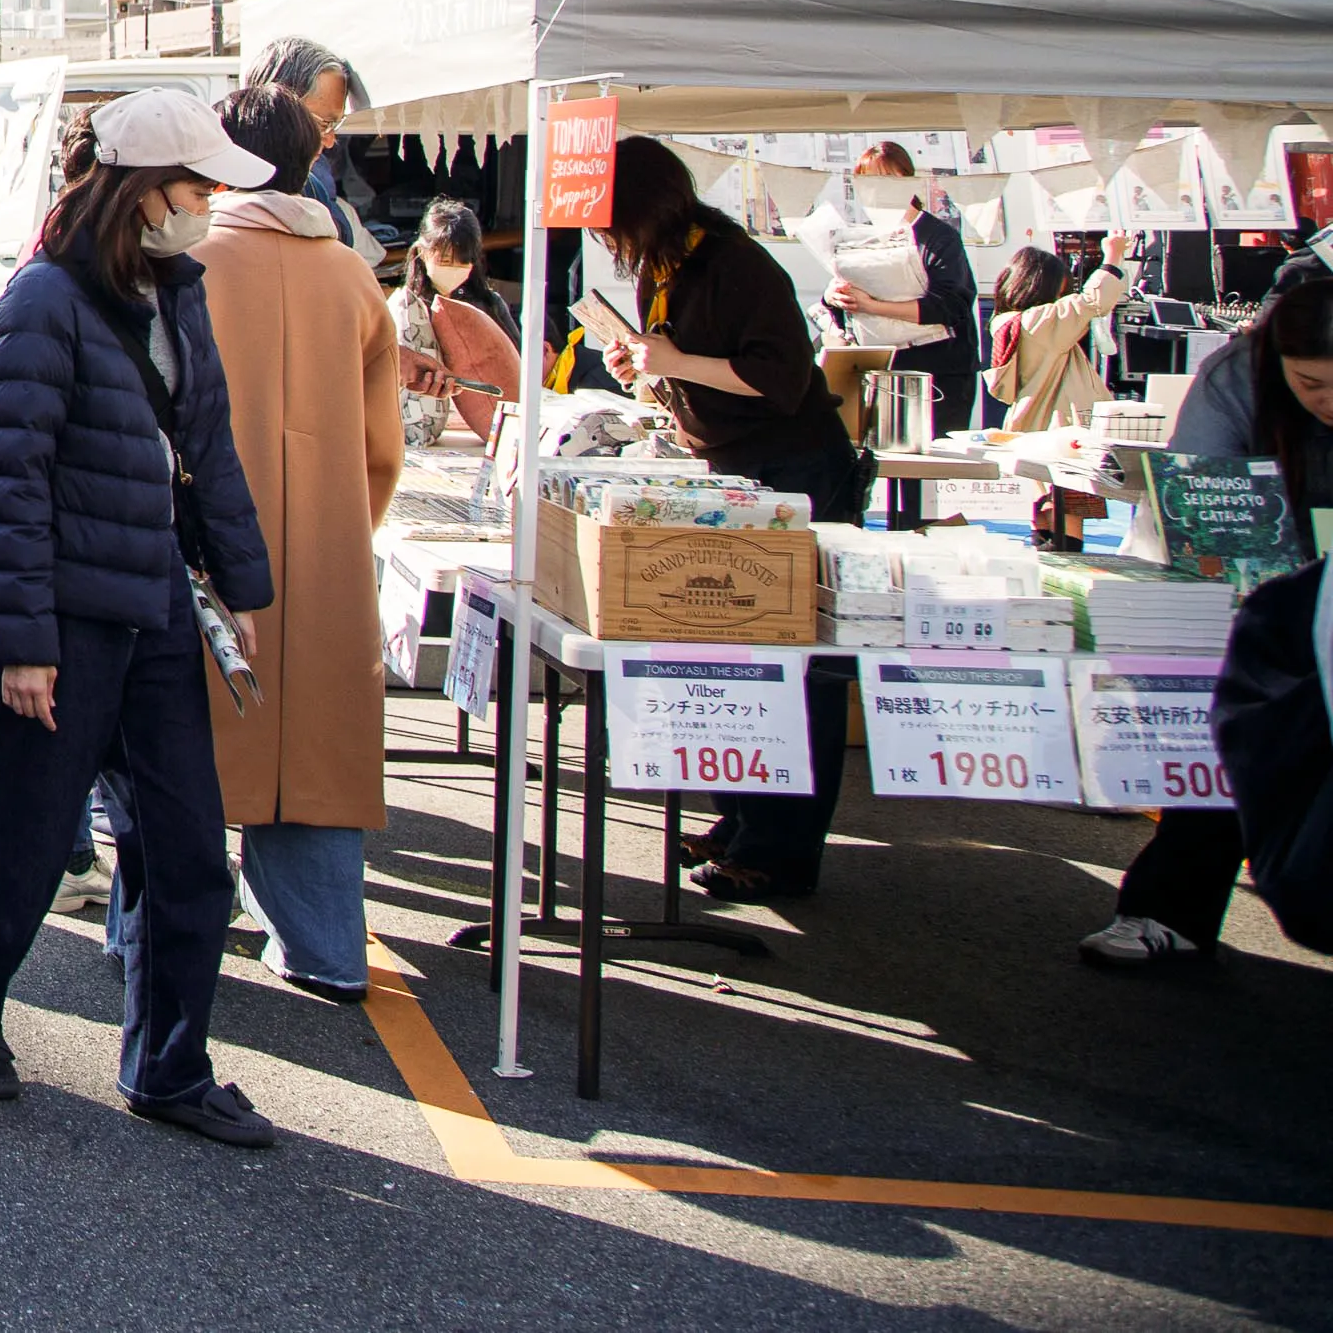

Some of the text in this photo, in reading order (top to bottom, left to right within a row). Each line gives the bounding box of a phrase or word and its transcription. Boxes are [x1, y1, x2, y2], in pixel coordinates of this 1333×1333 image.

[551, 115, 613, 156] TOMOYASU
[549, 183, 606, 218] Shopping
[1184, 476, 1252, 490] TOMOYASU
[1198, 510, 1254, 523] CATALOG
[640, 549, 779, 587] GRAND-PUY-LACOSTE
[778, 631, 797, 640] 2013
[645, 664, 764, 678] TOMOYASU THE SHOP
[903, 669, 1024, 683] TOMOYASU THE SHOP
[685, 684, 726, 698] Vilber
[645, 699, 769, 718] ランチョンマット
[875, 696, 1056, 717] 陶器製スイッチカバー
[1091, 705, 1210, 725] 友安製作所カ
[673, 746, 770, 784] 1804
[775, 769, 790, 784] 円
[929, 751, 1029, 789] 1980
